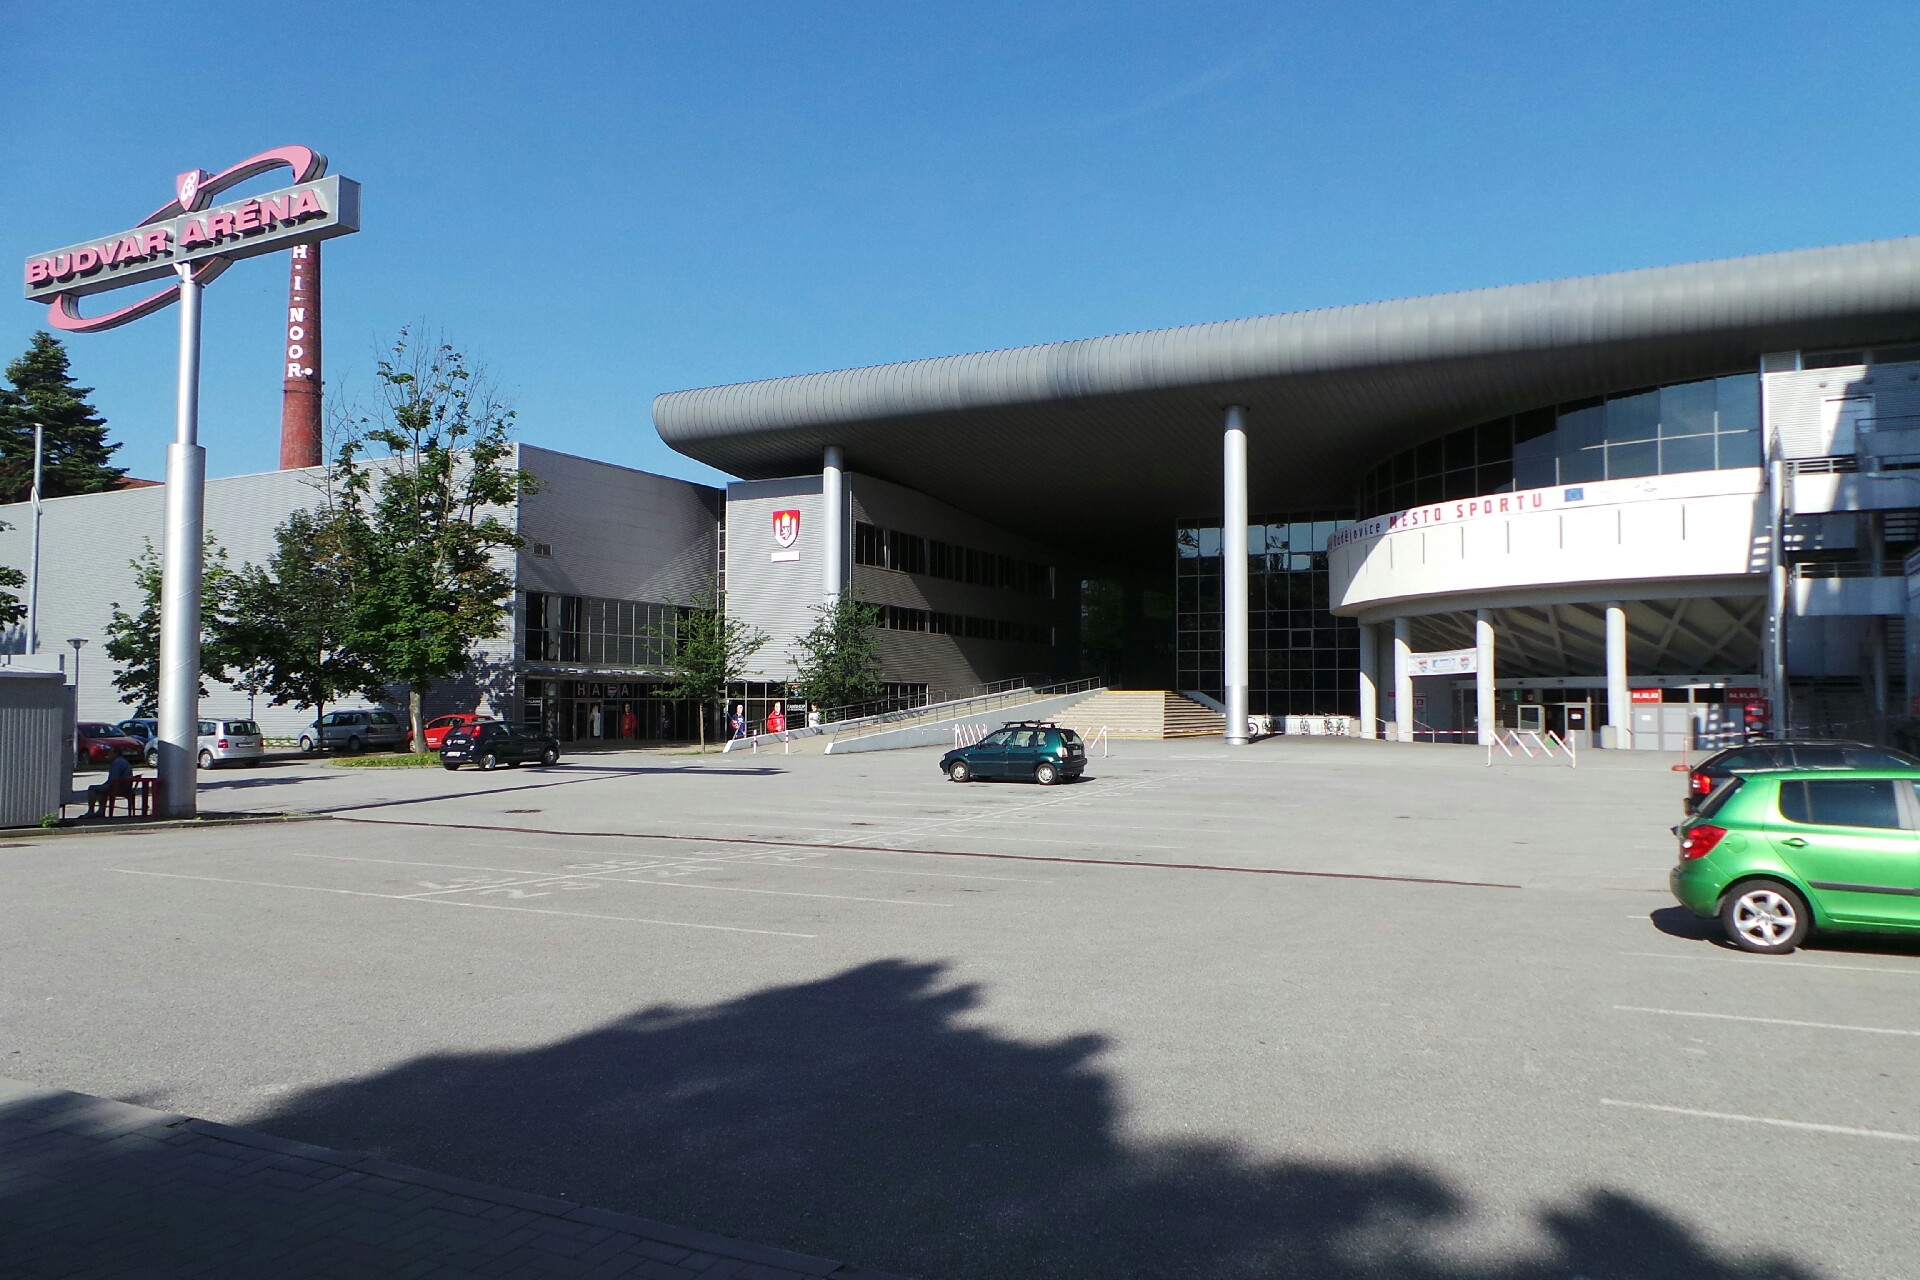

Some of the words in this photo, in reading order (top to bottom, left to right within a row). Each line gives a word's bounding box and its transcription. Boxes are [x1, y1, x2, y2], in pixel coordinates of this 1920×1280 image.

[26, 228, 170, 287] BUDVAR
[179, 188, 324, 248] ARÉNA
[1389, 507, 1441, 529] MĚSTO
[1456, 492, 1542, 519] SPORTU
